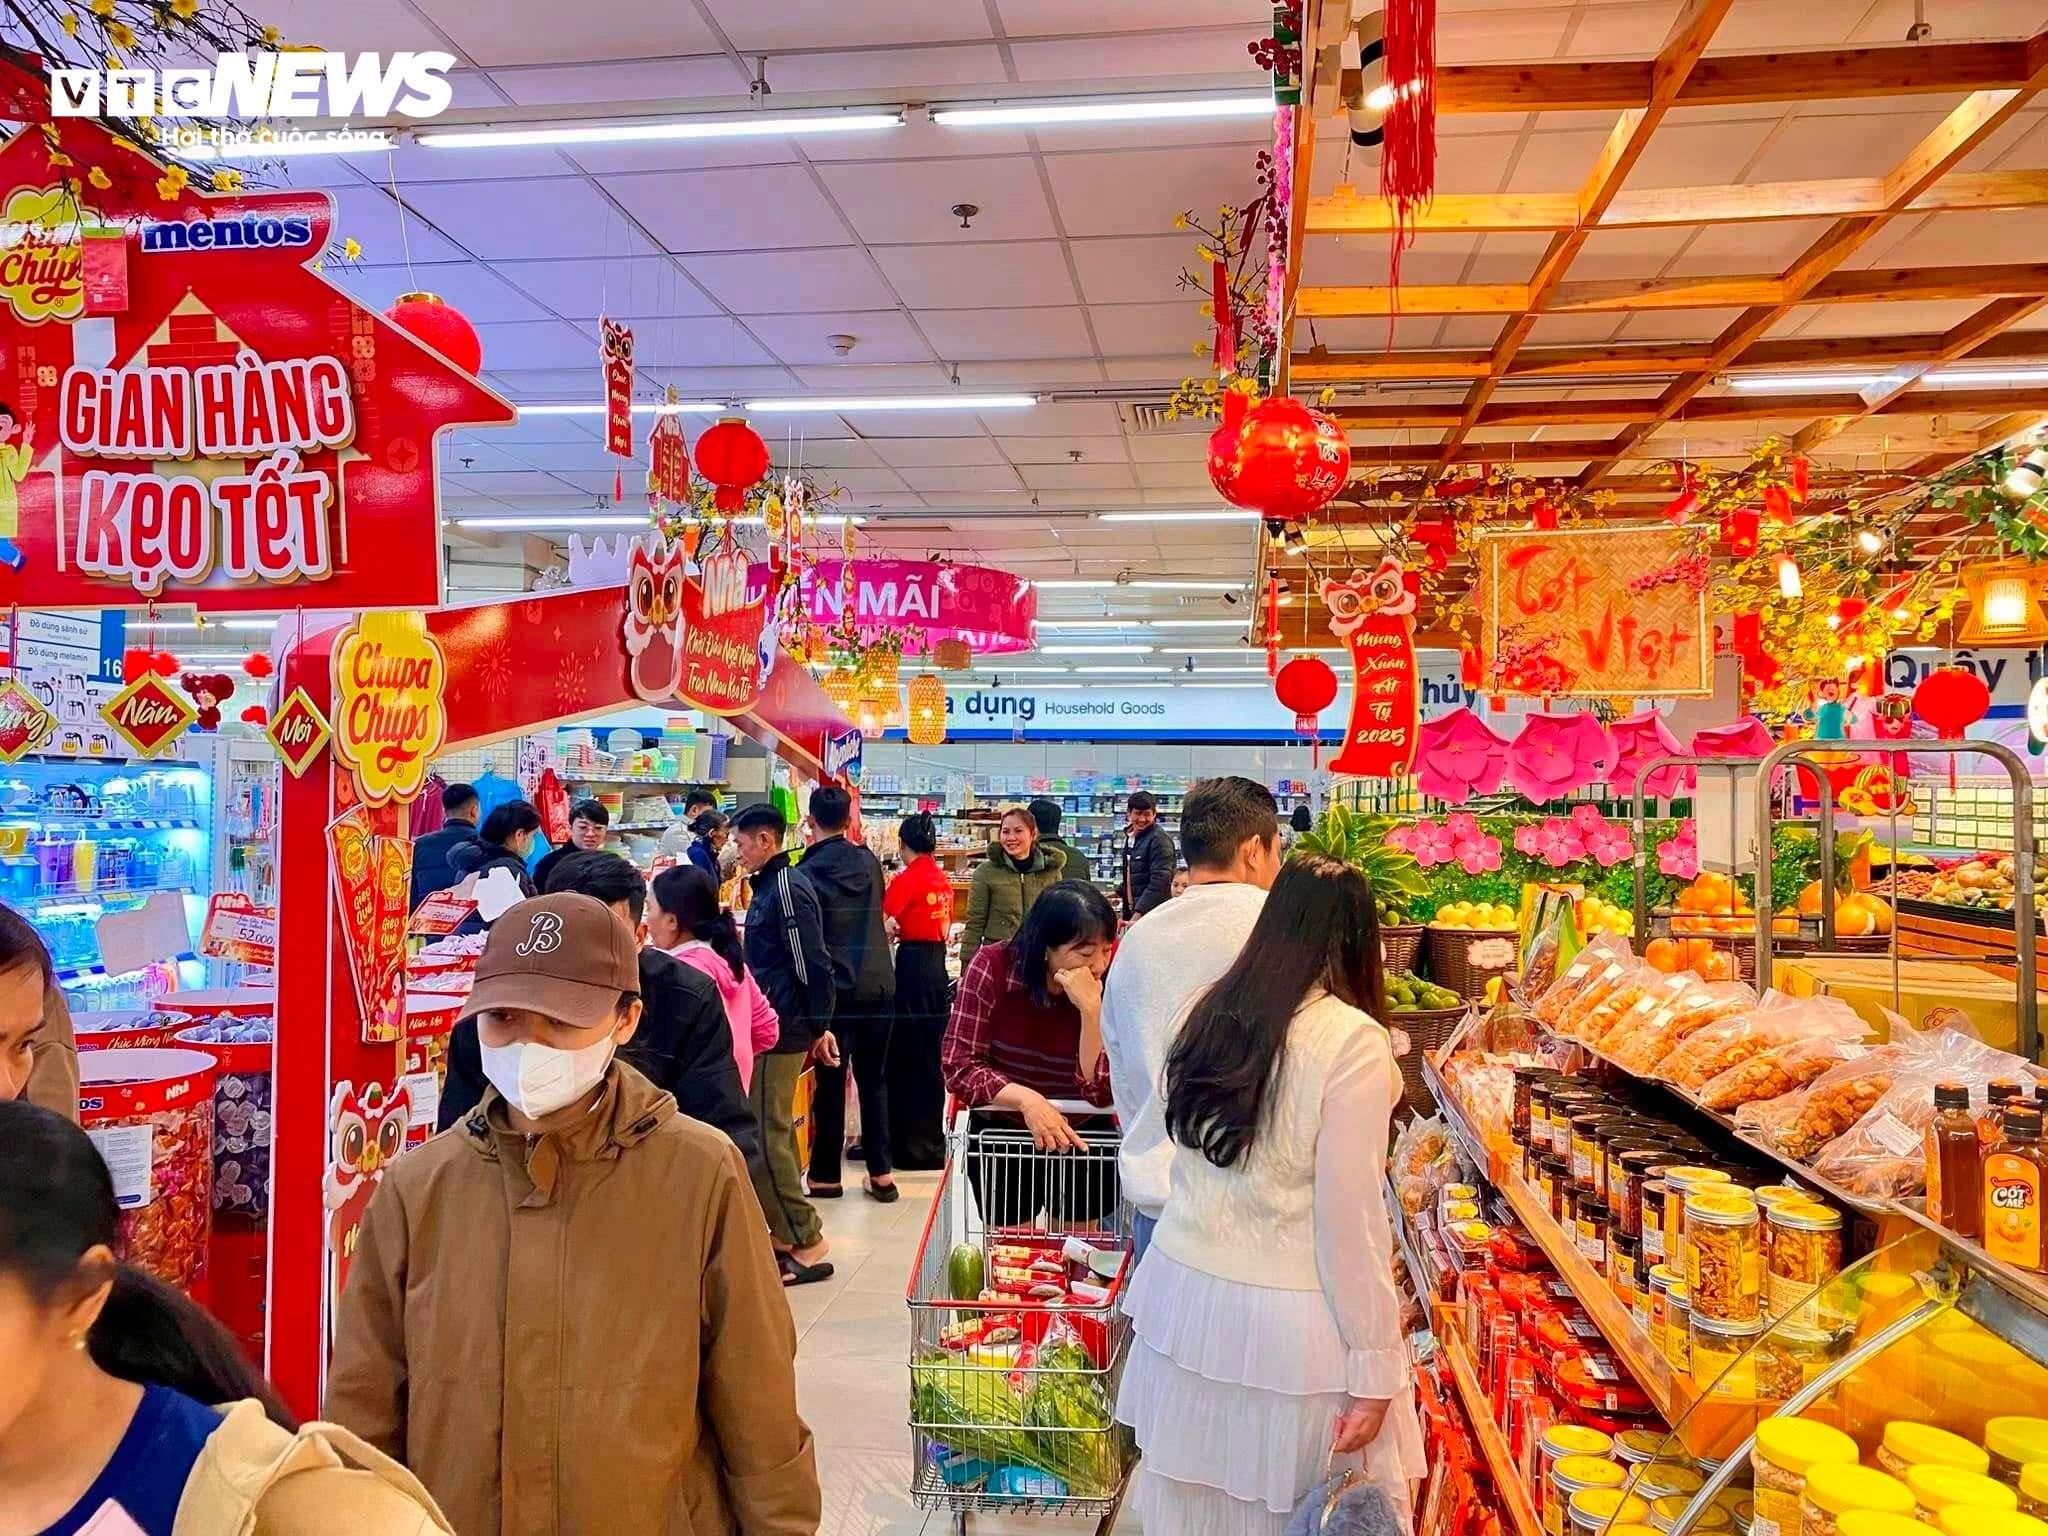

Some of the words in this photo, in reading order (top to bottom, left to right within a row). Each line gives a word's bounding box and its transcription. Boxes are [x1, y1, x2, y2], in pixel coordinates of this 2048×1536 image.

[144, 216, 312, 250] mentos
[199, 355, 348, 449] HÀNG
[703, 553, 749, 619] Nhà
[859, 574, 940, 619] MÃI
[1356, 631, 1403, 649] Mừng
[104, 658, 122, 678] 16
[352, 641, 433, 692] Chupa
[1359, 653, 1407, 675] Xuân
[965, 690, 1036, 721] dụng
[1045, 701, 1115, 716] Household
[1121, 702, 1166, 716] Goods
[1421, 673, 1477, 708] hủy
[120, 695, 178, 727] Năm
[280, 714, 314, 746] Mới
[349, 693, 430, 773] Chups
[1356, 726, 1406, 747] 2025
[516, 912, 564, 957] B
